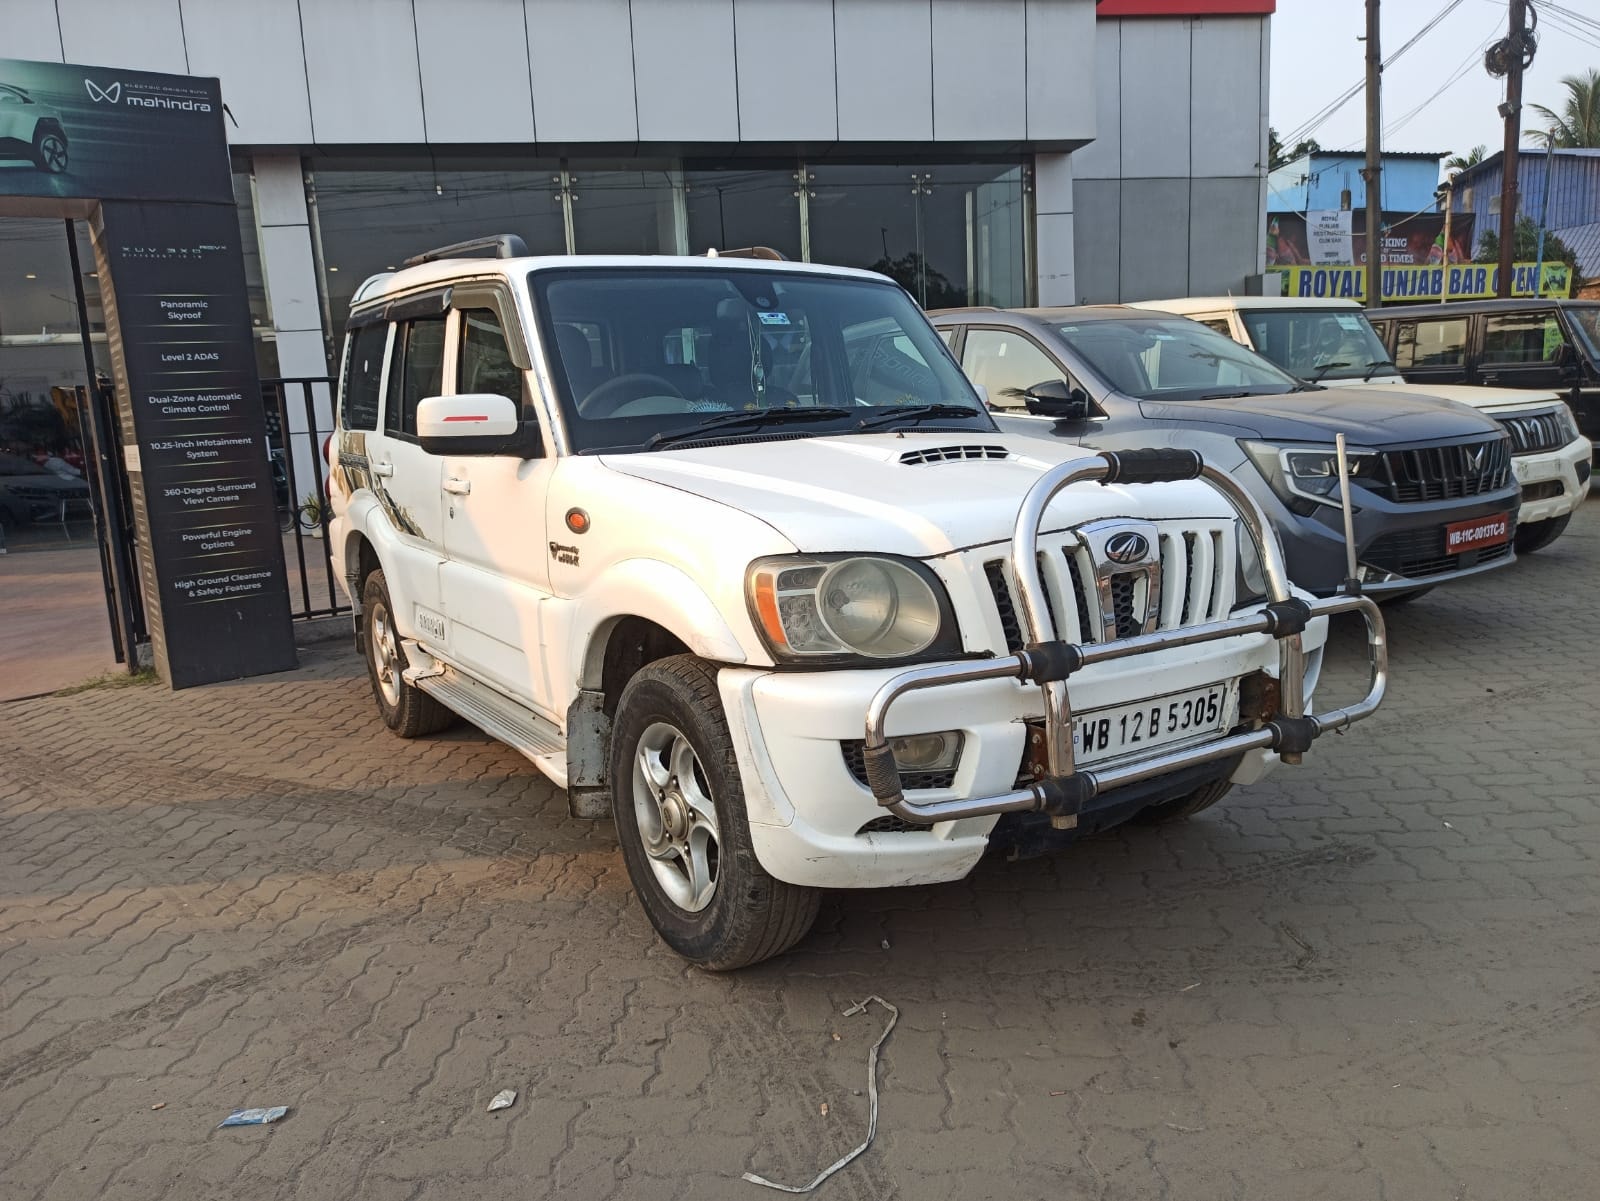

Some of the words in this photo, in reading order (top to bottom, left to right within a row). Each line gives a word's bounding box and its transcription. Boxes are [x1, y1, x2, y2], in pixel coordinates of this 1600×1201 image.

[126, 96, 211, 112] mahindra
[1385, 237, 1407, 248] KING
[1389, 254, 1414, 263] TIMES
[1299, 270, 1363, 297] ROYAL
[1383, 269, 1443, 297] UNJAB
[1448, 268, 1487, 295] BAR
[160, 300, 208, 309] Panoramic
[167, 311, 202, 321] Skyroof
[161, 353, 185, 361] Level
[185, 353, 193, 361] 2
[194, 352, 219, 361] ADAS
[148, 394, 195, 404] Dual-Zone
[197, 392, 242, 402] Automatic
[162, 404, 196, 414] Climate
[198, 403, 230, 412] Control
[150, 440, 194, 450] 10.25-inch
[196, 437, 252, 448] Infotainment
[186, 450, 219, 459] System
[164, 486, 215, 497] 360-Degree
[216, 482, 256, 491] Surround
[182, 496, 204, 505] View
[206, 494, 239, 503] Camera
[182, 530, 221, 542] Powerful
[222, 528, 252, 538] Engine
[201, 540, 235, 550] Options
[174, 579, 196, 590] High
[197, 576, 229, 586] Ground
[230, 570, 272, 581] Clearance
[197, 586, 223, 597] Safety
[225, 582, 262, 593] Features
[1082, 718, 1111, 754] WB
[1119, 711, 1142, 746] 12
[1149, 707, 1161, 738] B
[1167, 693, 1218, 732] 5305
